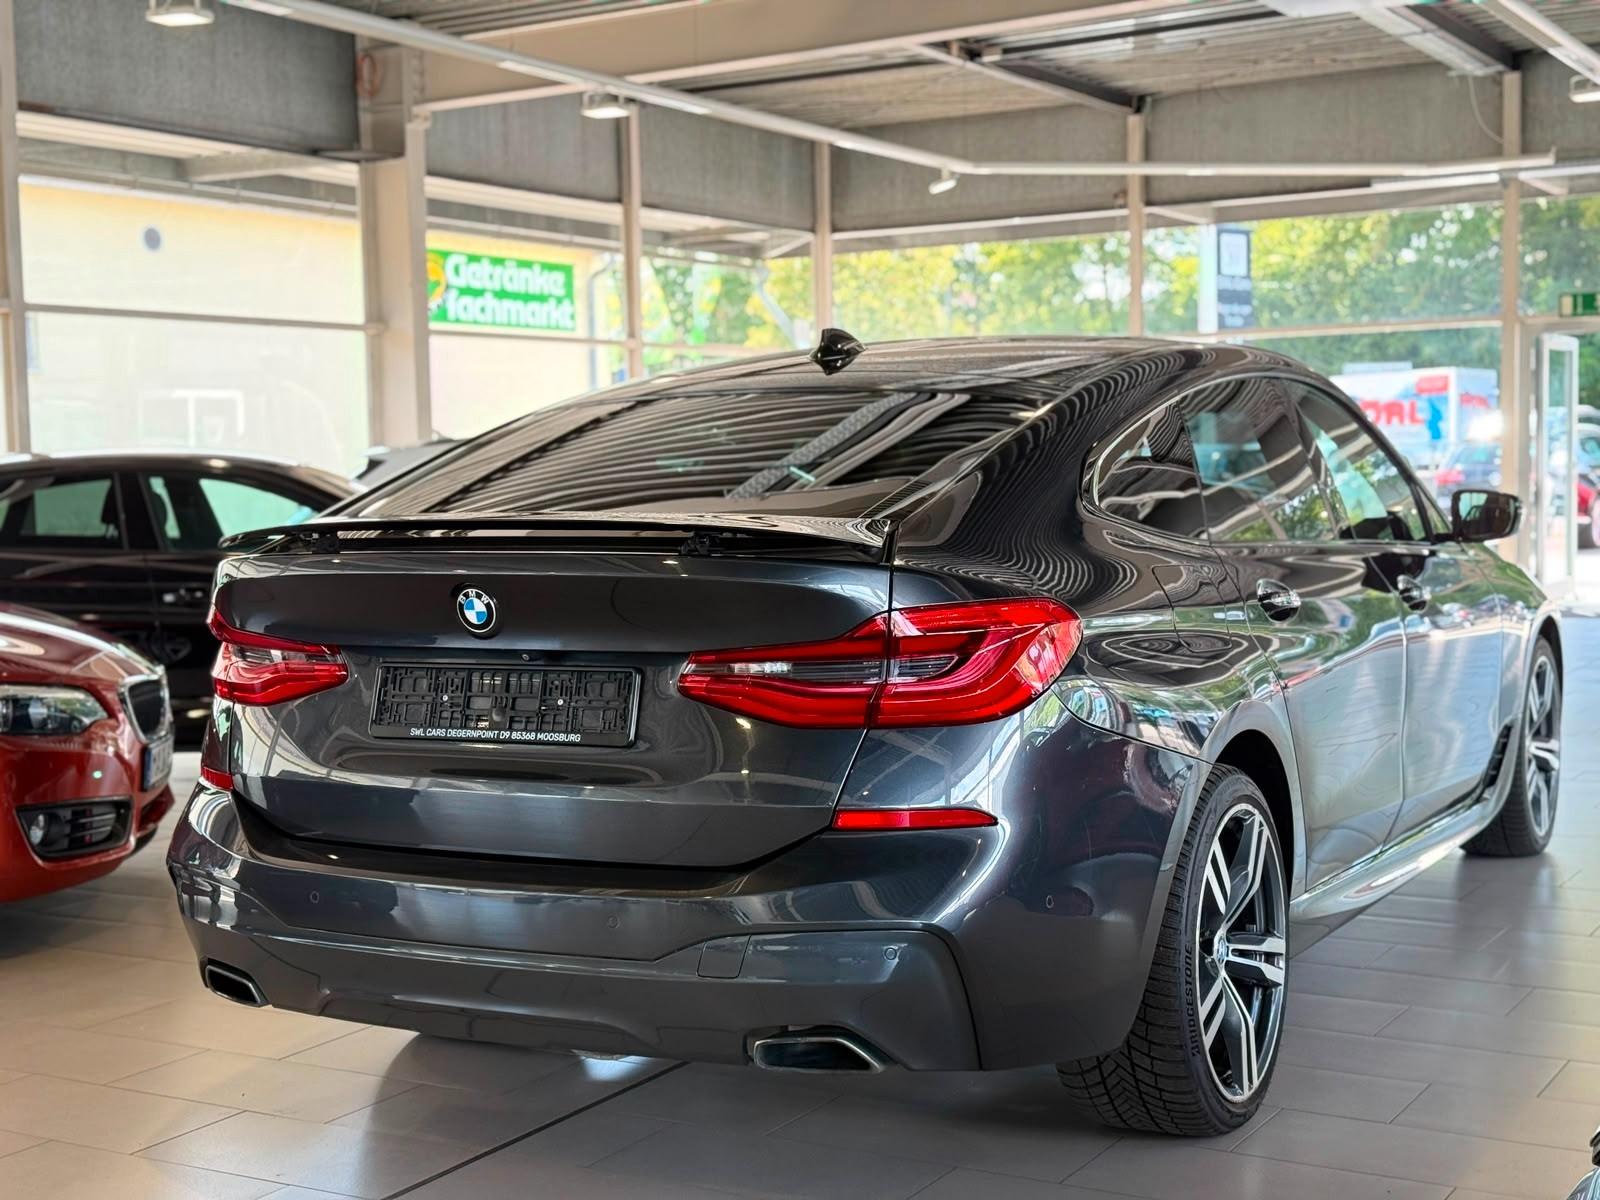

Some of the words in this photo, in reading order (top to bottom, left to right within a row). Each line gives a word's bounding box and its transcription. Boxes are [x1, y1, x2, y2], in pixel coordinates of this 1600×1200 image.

[445, 253, 565, 297] Getränke
[410, 727, 425, 736] SWL
[426, 728, 446, 737] CARS
[447, 729, 499, 739] DEGERNPOINT
[500, 730, 510, 739] D9
[511, 731, 536, 740] 85368
[537, 732, 581, 742] MOOSBURG
[1184, 943, 1200, 1057] BRIDGESTONE
